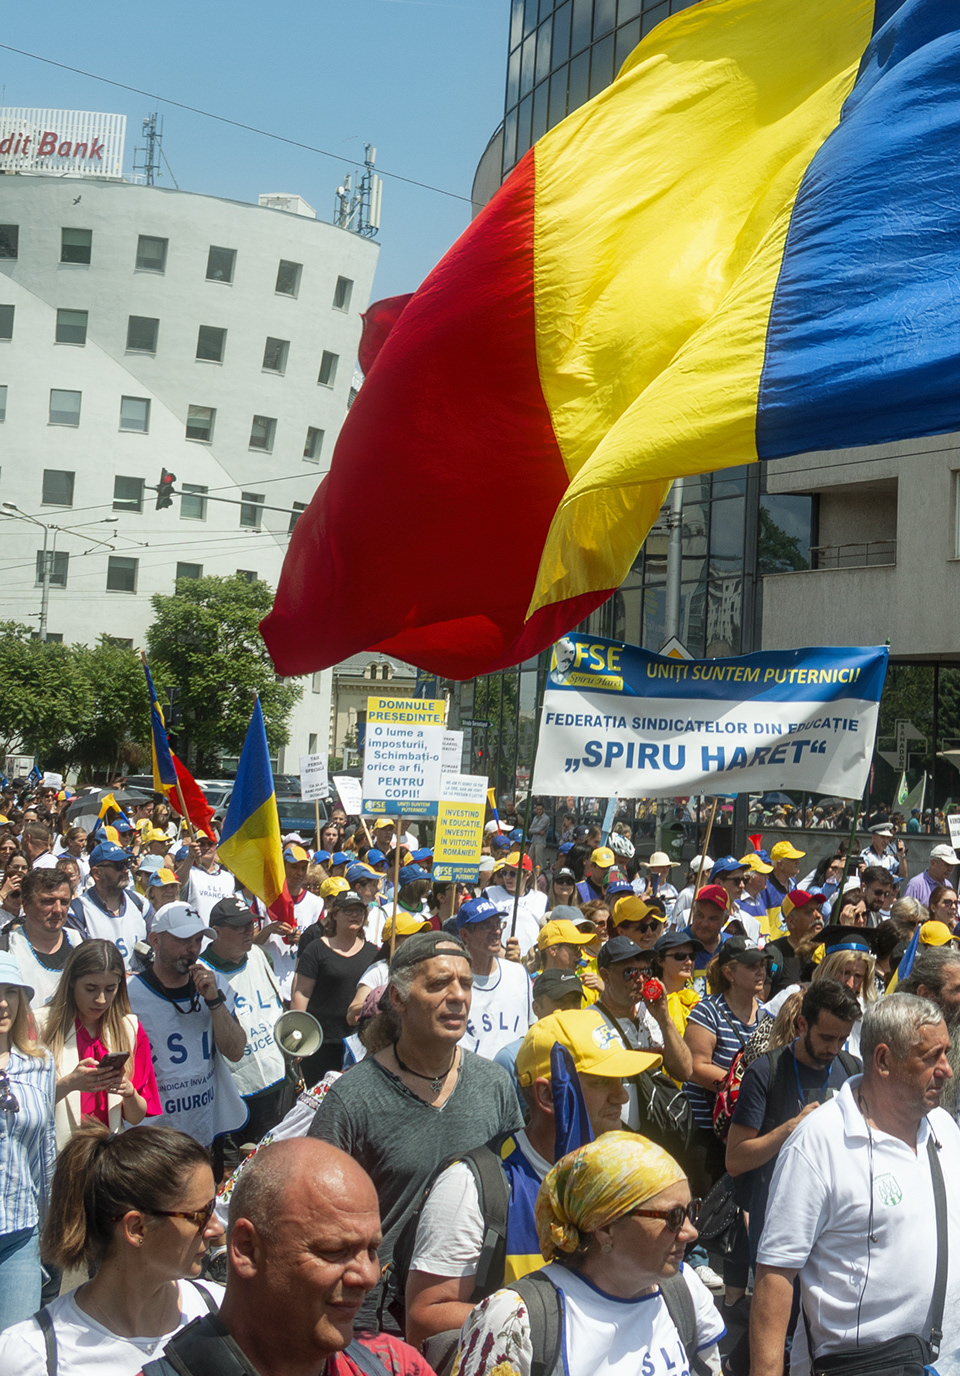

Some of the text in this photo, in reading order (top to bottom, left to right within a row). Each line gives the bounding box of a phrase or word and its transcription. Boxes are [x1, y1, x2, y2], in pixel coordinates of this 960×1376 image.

[37, 131, 105, 160] Bank
[573, 642, 624, 671] FSE
[647, 663, 860, 685] UNIȚI SUNTEM PUTERNICI!
[570, 674, 623, 689] Spiru Haret
[379, 700, 435, 711] DOMNULE
[369, 711, 444, 725] PREȘEDINTE,
[545, 712, 859, 735] FEDERAȚIA SINDICATELOR DIN EDUCAȚIE
[375, 727, 382, 736] O
[386, 727, 414, 737] lume
[368, 738, 428, 751] imposturii,
[374, 750, 440, 763] Schimbați-o
[564, 740, 687, 774] „SPIRU
[367, 762, 424, 774] orice ar fi,
[378, 777, 425, 787] PENTRU
[385, 788, 420, 799] COPII!
[372, 800, 386, 809] FSE
[446, 809, 479, 818] INVESTIND
[450, 839, 478, 847] VIITORUL
[440, 866, 452, 876] FSE
[244, 1036, 274, 1056] SUCE
